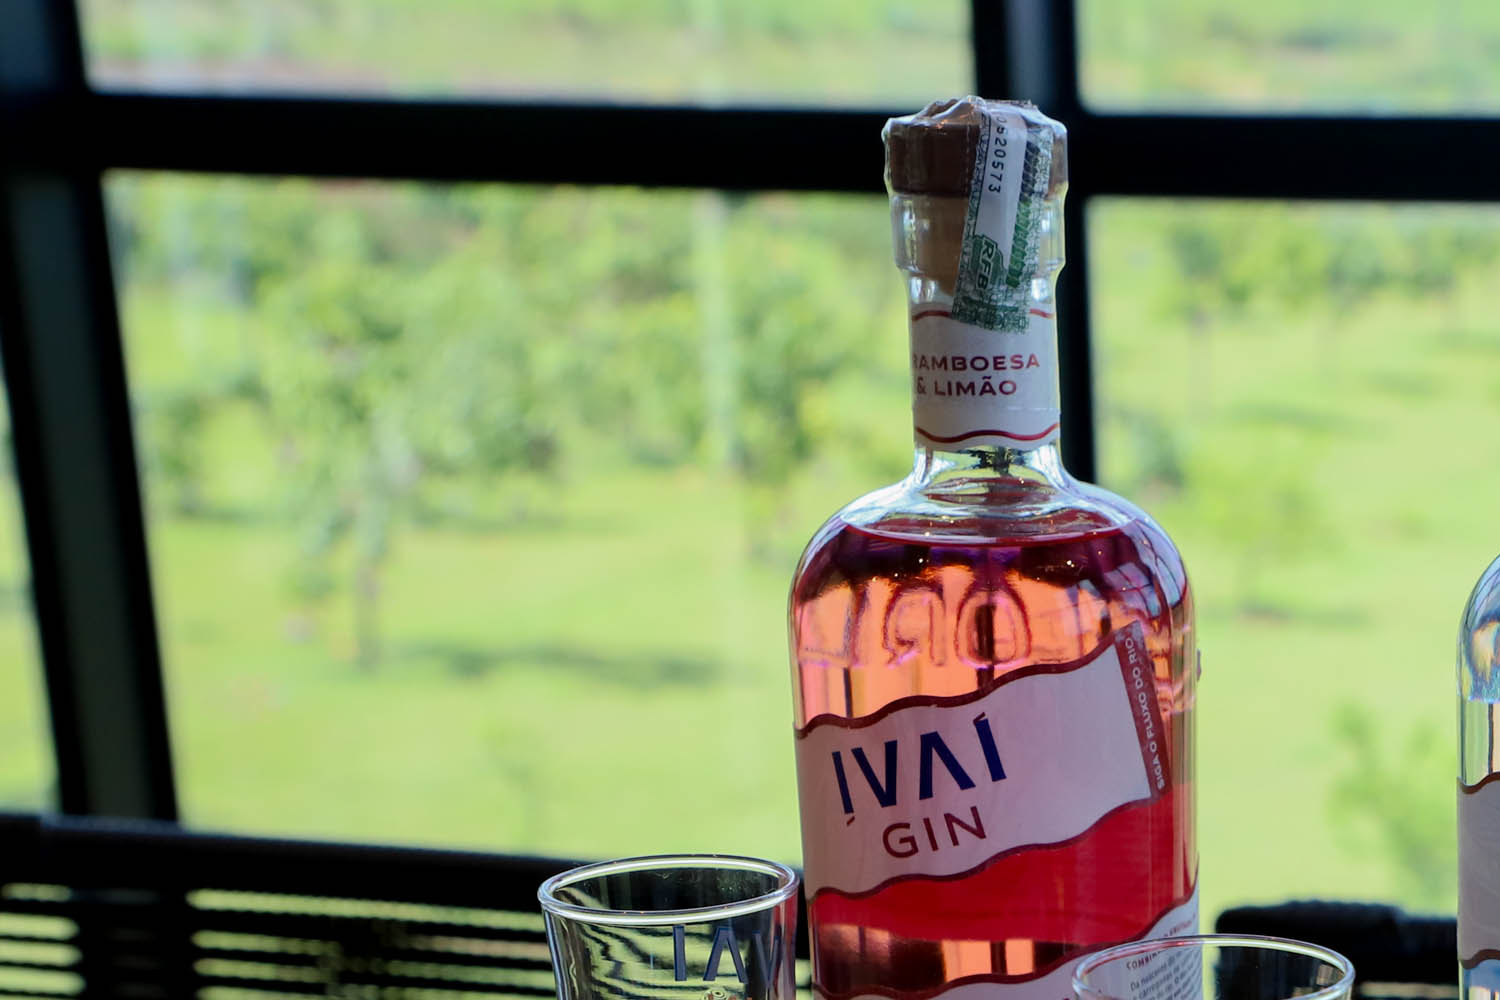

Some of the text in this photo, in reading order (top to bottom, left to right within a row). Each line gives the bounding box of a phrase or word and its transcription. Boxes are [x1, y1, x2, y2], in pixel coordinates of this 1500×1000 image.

[976, 241, 997, 290] RFB
[916, 375, 1017, 396] & LIMÃO
[1125, 637, 1138, 664] RIO
[1132, 666, 1144, 689] DO
[1138, 692, 1155, 738] FLUXO
[882, 805, 988, 858] GIN
